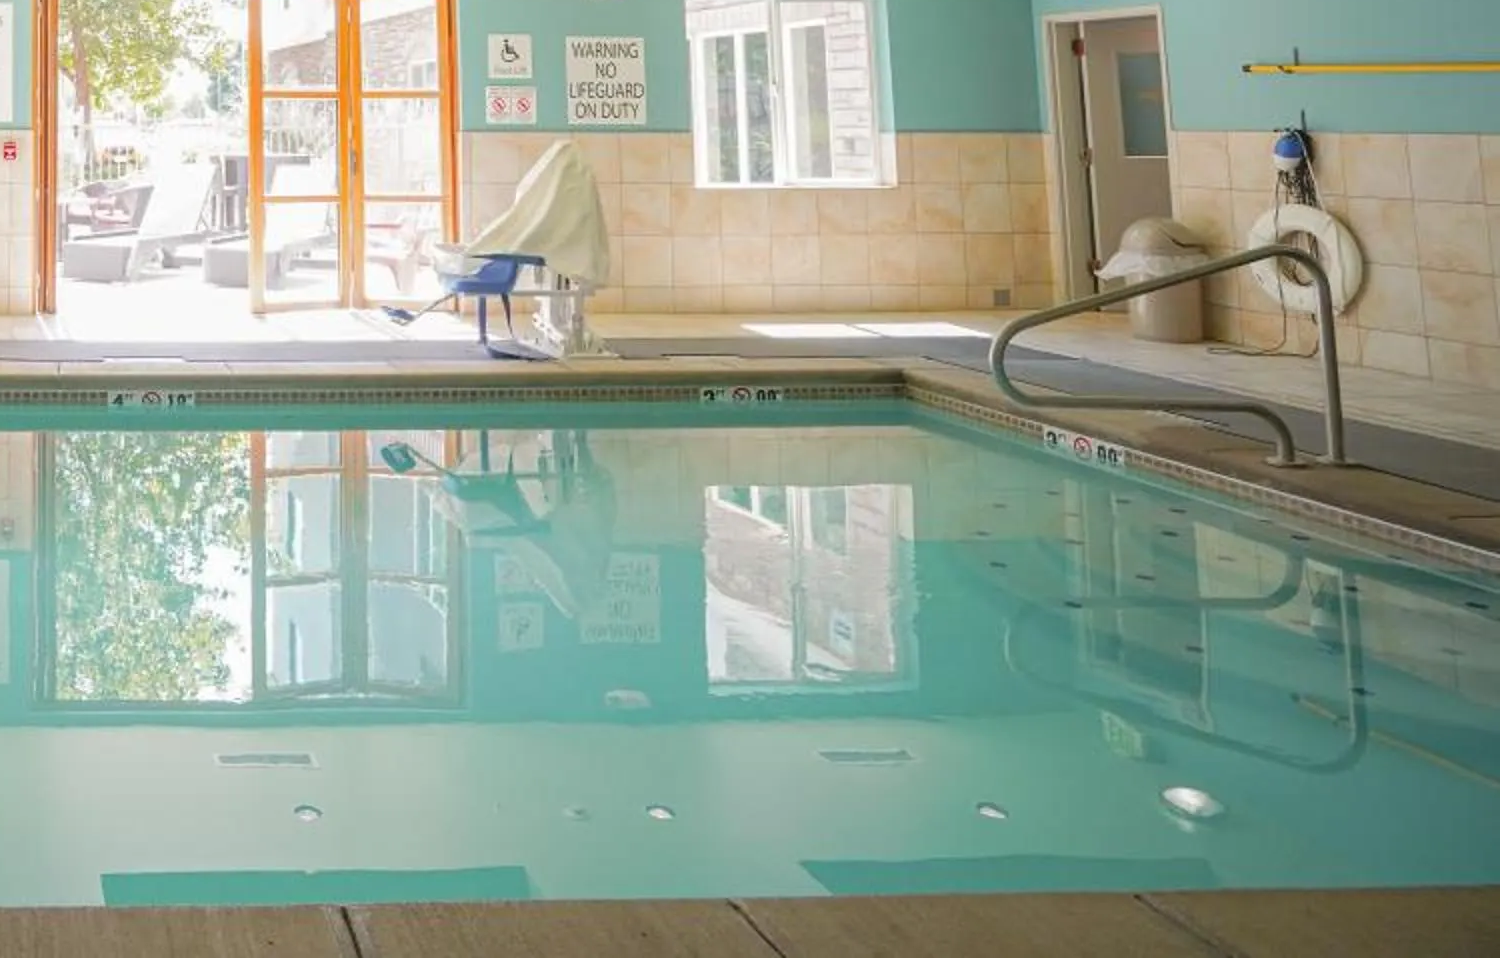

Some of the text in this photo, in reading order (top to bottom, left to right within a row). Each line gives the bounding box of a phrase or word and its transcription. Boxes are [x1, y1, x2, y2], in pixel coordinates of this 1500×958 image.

[571, 43, 639, 59] WARNING
[595, 61, 617, 79] NO
[569, 82, 645, 99] LIFEGUARD
[575, 103, 639, 119] ON DUTY
